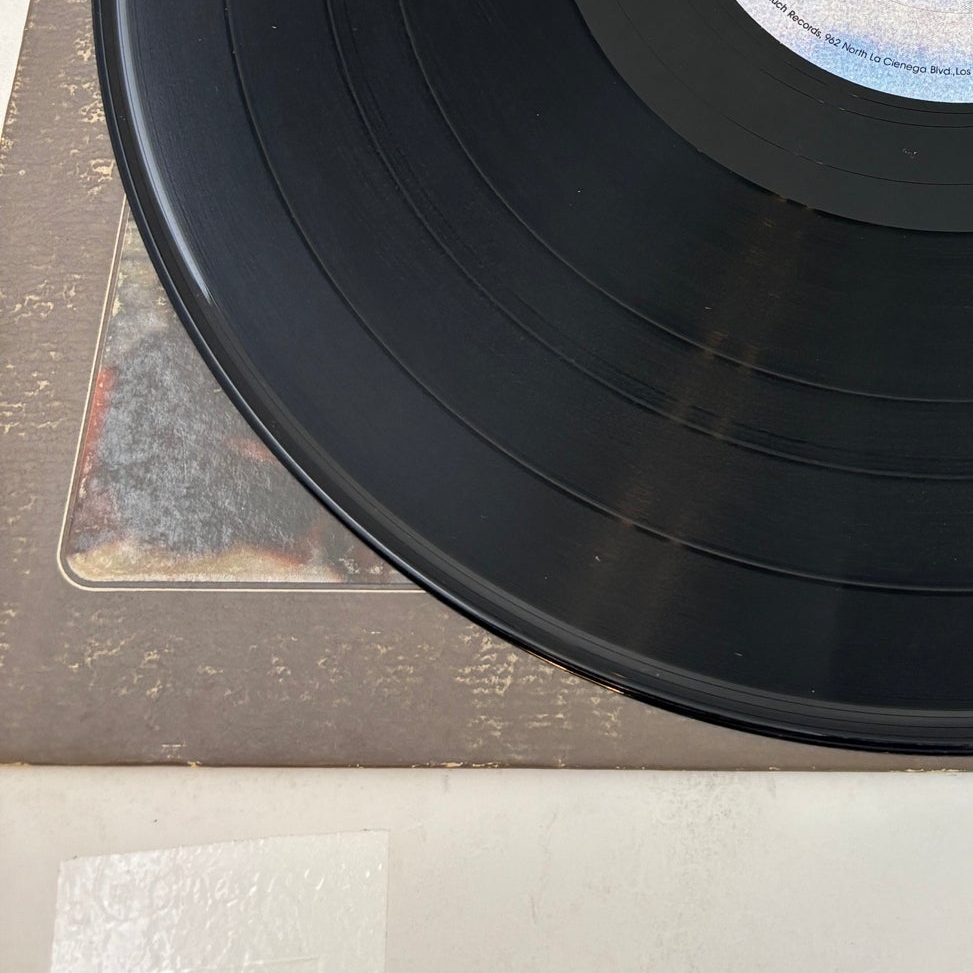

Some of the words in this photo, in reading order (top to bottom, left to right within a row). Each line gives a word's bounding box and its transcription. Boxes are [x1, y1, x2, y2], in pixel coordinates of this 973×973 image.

[825, 33, 841, 47] 962
[842, 42, 868, 58] North
[870, 53, 882, 63] La
[883, 57, 927, 74] Cienega
